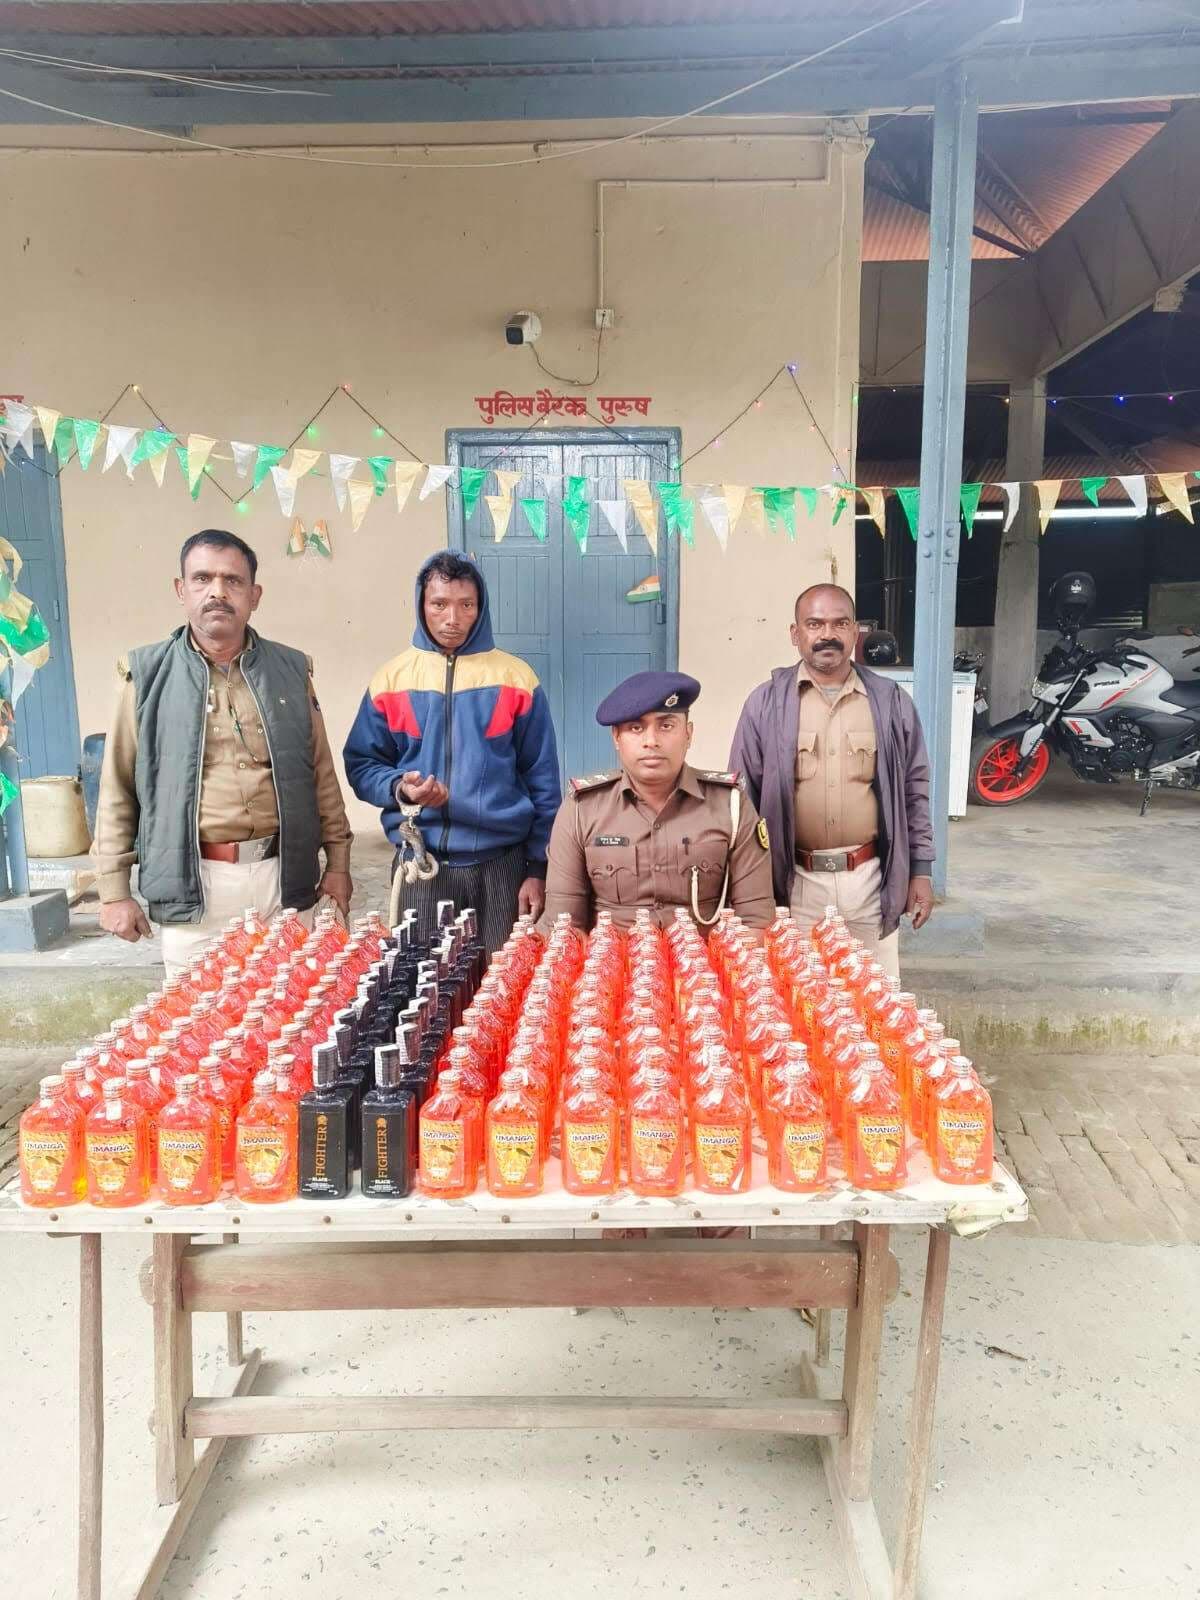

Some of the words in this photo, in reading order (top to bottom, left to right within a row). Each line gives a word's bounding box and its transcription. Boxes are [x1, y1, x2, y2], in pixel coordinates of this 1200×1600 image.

[474, 390, 535, 425] पुलिस
[536, 388, 587, 417] बैरक
[316, 1126, 328, 1176] FIGHTER
[376, 1129, 389, 1178] FIGHTER
